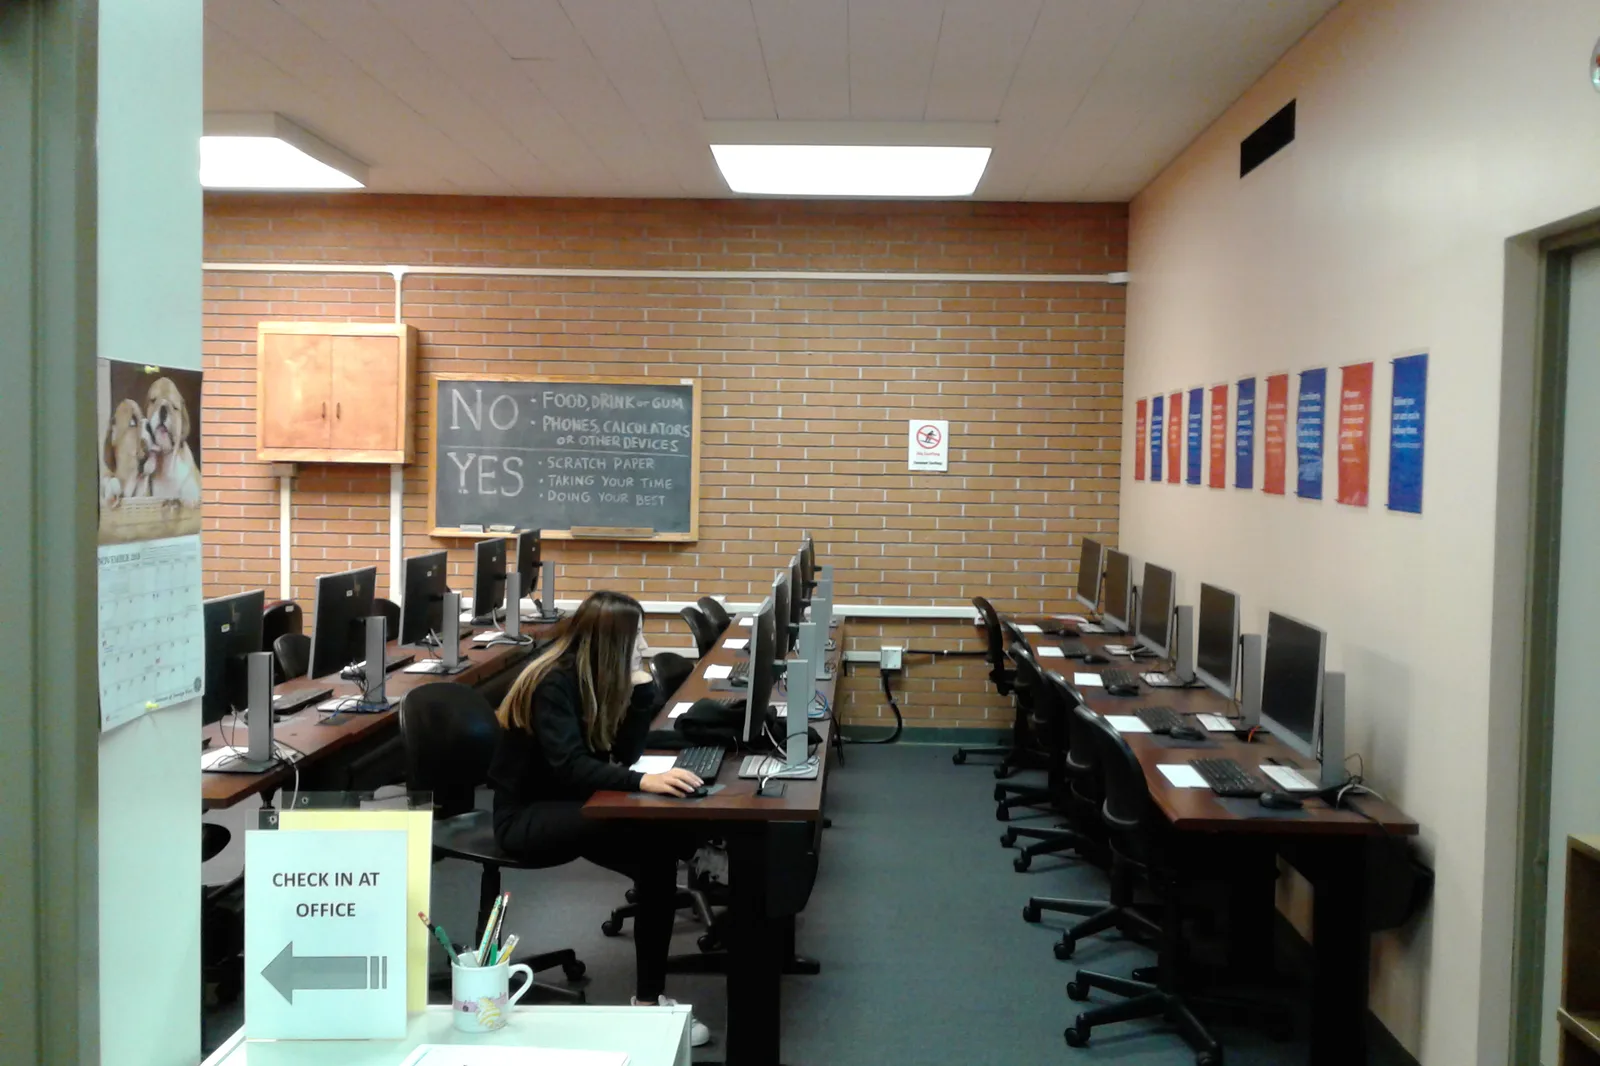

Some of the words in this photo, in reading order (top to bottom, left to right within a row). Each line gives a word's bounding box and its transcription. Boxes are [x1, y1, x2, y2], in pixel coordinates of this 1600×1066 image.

[449, 388, 519, 431] NO
[591, 393, 636, 409] DRINK
[651, 396, 685, 410] GUM
[603, 420, 691, 438] CALCULATORS
[579, 435, 621, 447] OTHER
[623, 437, 679, 452] DEVICES
[547, 456, 606, 470] SCRATCH
[613, 457, 655, 470] PAPER
[447, 452, 524, 497] YES
[547, 474, 595, 487] TAKING
[601, 475, 634, 488] YOUR
[640, 477, 673, 490] TIME
[547, 490, 591, 503] DOING
[598, 492, 629, 503] YOUR
[635, 494, 666, 506] BEST
[272, 872, 329, 887] CHECK
[335, 872, 353, 886] IN
[358, 872, 380, 886] AT
[296, 902, 356, 917] OFFICE
